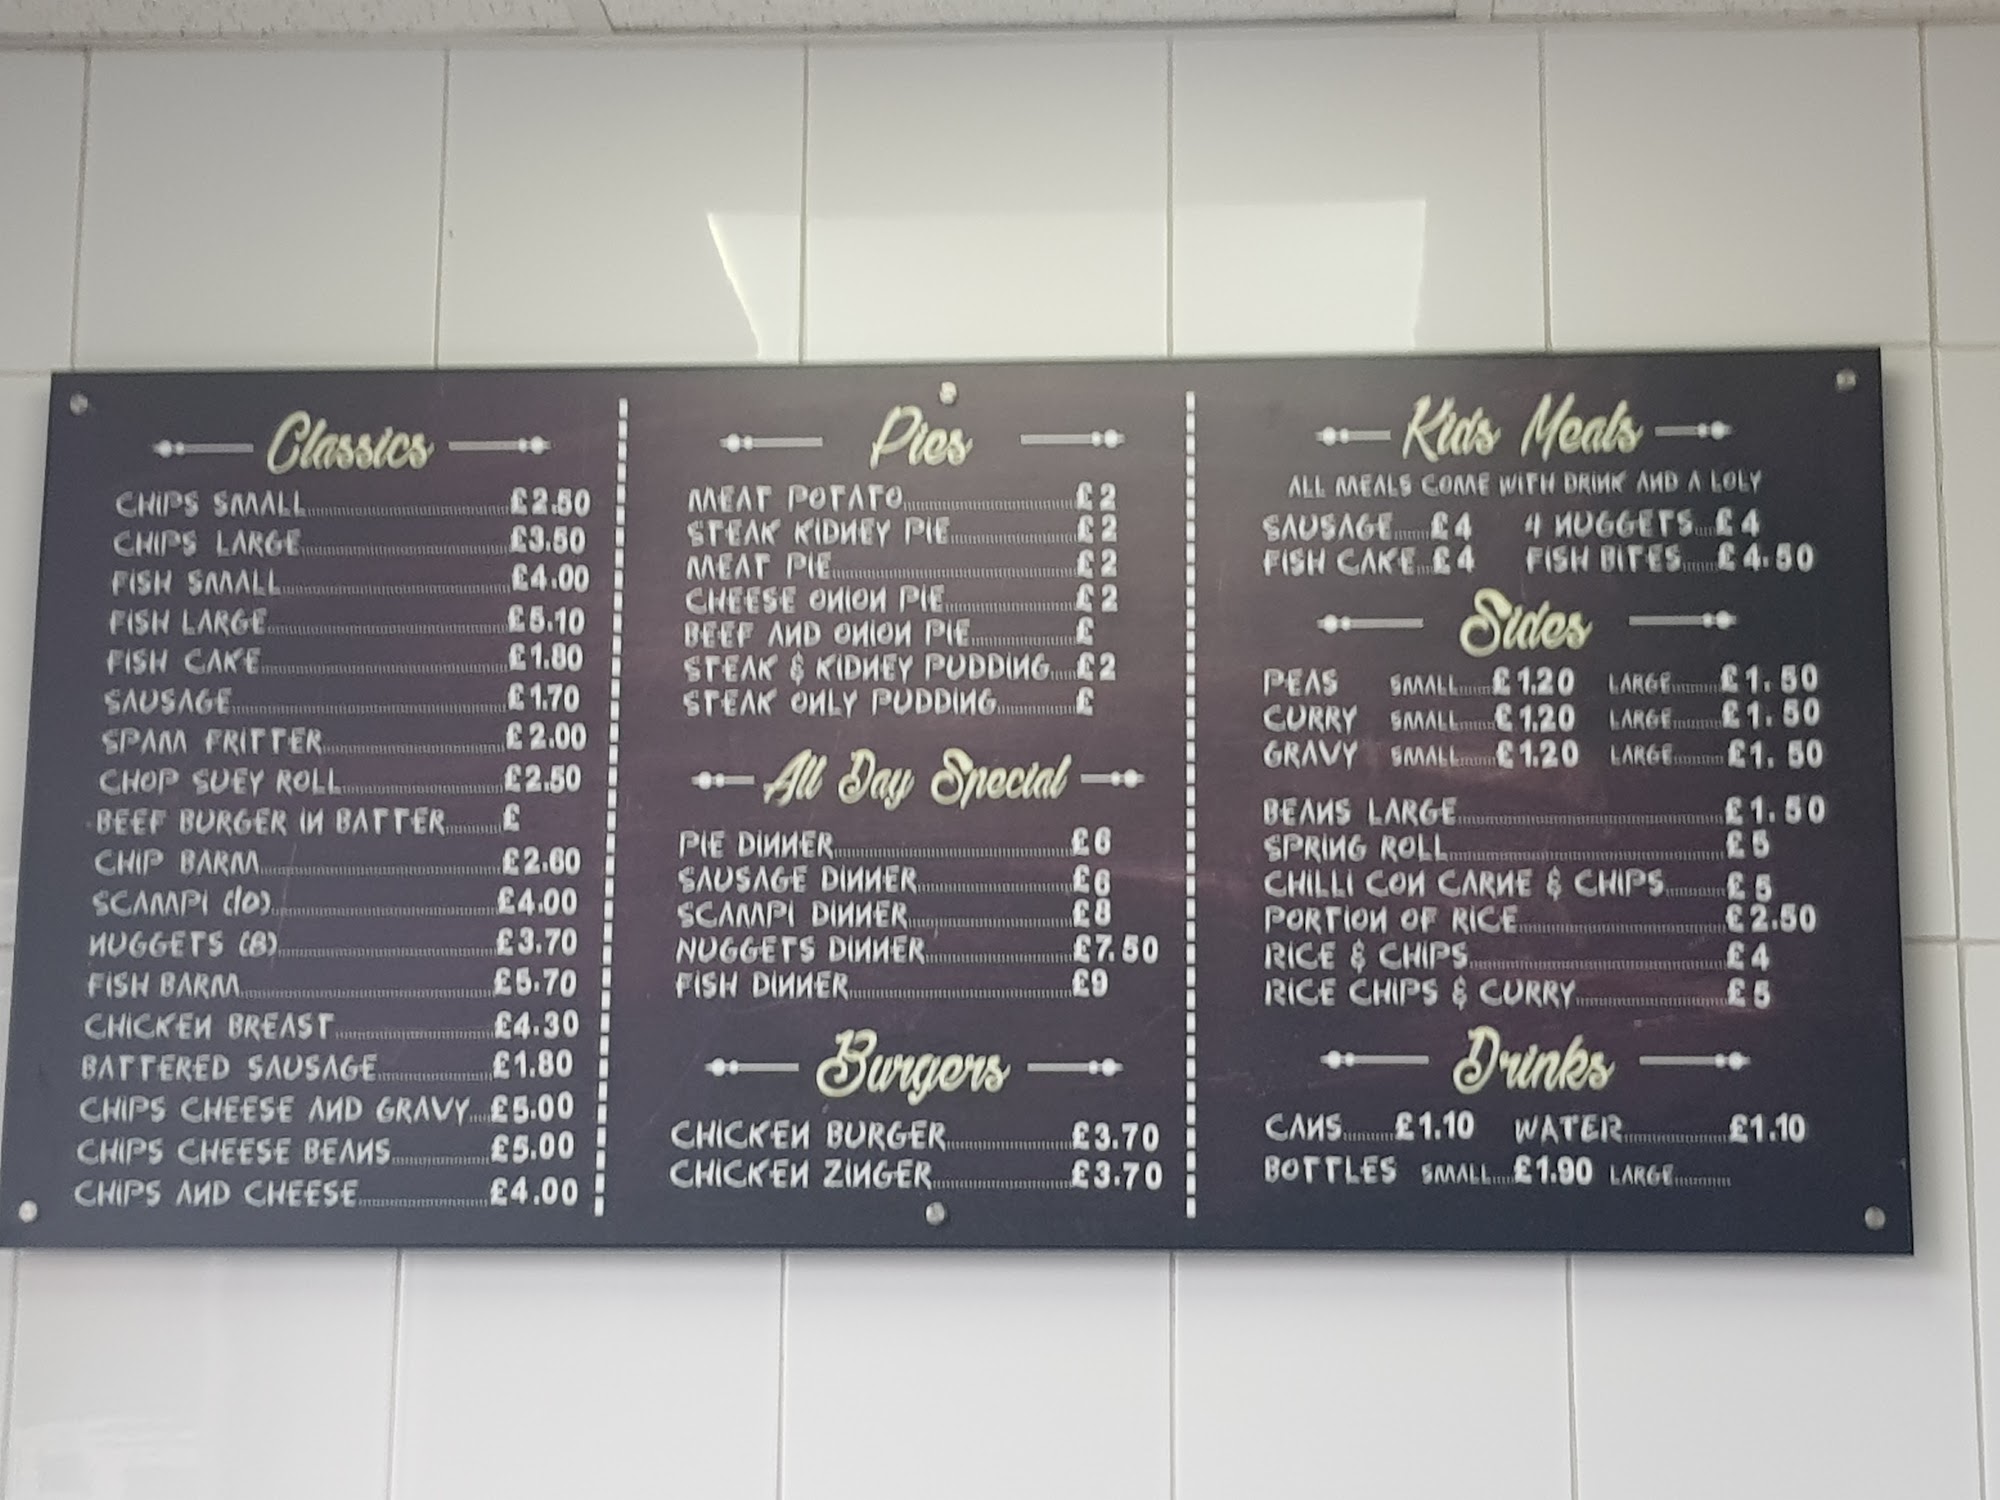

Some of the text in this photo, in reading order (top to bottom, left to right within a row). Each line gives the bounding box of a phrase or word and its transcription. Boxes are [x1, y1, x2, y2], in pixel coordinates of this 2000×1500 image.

[870, 404, 973, 470] Pies
[1402, 392, 1644, 462] Kids Meals
[267, 410, 434, 475] Classics
[688, 484, 903, 512] MEAT POTATO
[1289, 469, 1762, 498] ALL MEALS COME WITH DRINK AND A LOLY
[116, 491, 303, 518] CHIPS SMALL
[687, 517, 950, 548] STEAK KIDNEY PIE
[1263, 513, 1393, 542] SAUSAGE
[1525, 508, 1693, 538] 4 NUGGETS
[114, 529, 300, 557] CHIPS LARGE
[686, 552, 832, 580] MEAT PIE
[1263, 547, 1415, 576] FISH CAKE
[1526, 544, 1682, 575] FISH BITES
[112, 565, 589, 597] FISH SMALL £4.00
[686, 584, 944, 615] CHEESE ONION PIE
[110, 608, 267, 636] FISH LARGE
[684, 619, 970, 648] BEEF AND ONION PIE
[1460, 587, 1593, 658] Sides
[108, 647, 260, 675] FISH CAKE
[683, 654, 777, 683] STEAK
[816, 653, 912, 683] KIDNEY
[925, 652, 1050, 681] PUDDING
[1263, 668, 1671, 696] PEAS SMALL LARGE
[104, 687, 231, 716] SAUSAGE
[683, 687, 998, 718] STEAK ONLY PUDDING
[1263, 704, 1671, 734] CURRY SMALL LARGE
[102, 728, 322, 756] SPAM FRITTER
[1263, 739, 1672, 769] GRAVY SMALL LARGE
[100, 768, 341, 796] CHOP SUEY ROLL
[764, 748, 1072, 811] All Day Special
[96, 808, 444, 836] BEEF BURGER IN BATTER
[1263, 797, 1457, 826] BEANS LARGE
[679, 830, 833, 859] PIE DINNER
[1263, 834, 1448, 863] SPRING ROLL
[95, 849, 259, 877] CHIP BARM
[678, 865, 917, 894] SAUSAGE DINNER
[1263, 869, 1353, 898] CHILLI
[1366, 869, 1426, 898] CON
[1438, 868, 1532, 897] CARNE
[1575, 868, 1665, 898] CHIPS
[92, 888, 207, 918] SCAMPI
[498, 886, 578, 915] £4.00
[677, 900, 908, 930] SCAMPI DINNER
[1263, 905, 1518, 934] PORTION OF RICE
[89, 931, 223, 958] NUGGETS
[497, 927, 577, 956] £3.70
[676, 935, 925, 965] NUGGETS DINNER
[1263, 942, 1336, 971] RICE
[1380, 942, 1468, 970] CHIPS
[88, 968, 577, 999] FISH BARM £5.70
[675, 968, 1109, 1000] FISH DINNER £9
[1263, 978, 1336, 1006] RICE
[1349, 978, 1438, 1006] CHIPS
[1480, 979, 1576, 1009] CURRY
[85, 1009, 579, 1041] CHICKEN BREAST £4.30
[82, 1050, 573, 1082] BATTERED SAUSAGE £1.80
[816, 1028, 1011, 1106] Burgers
[1452, 1025, 1615, 1095] Drinks
[80, 1091, 574, 1126] CHIPS CHEESE AND GRAVY £5.00
[671, 1119, 1160, 1152] CHICKEN BURGER £3.70
[1265, 1111, 1474, 1142] CANS £1.10
[1514, 1113, 1806, 1144] WATER £1.10
[77, 1132, 574, 1166] CHIPS CHEESE BEANS £5.00
[670, 1158, 1163, 1191] CHICKEN ZINGER £3.70
[1263, 1156, 1673, 1186] BOTTLES SMALL £1.90 LARGE
[75, 1177, 579, 1207] CHIPS AND CHEESE £4.00
